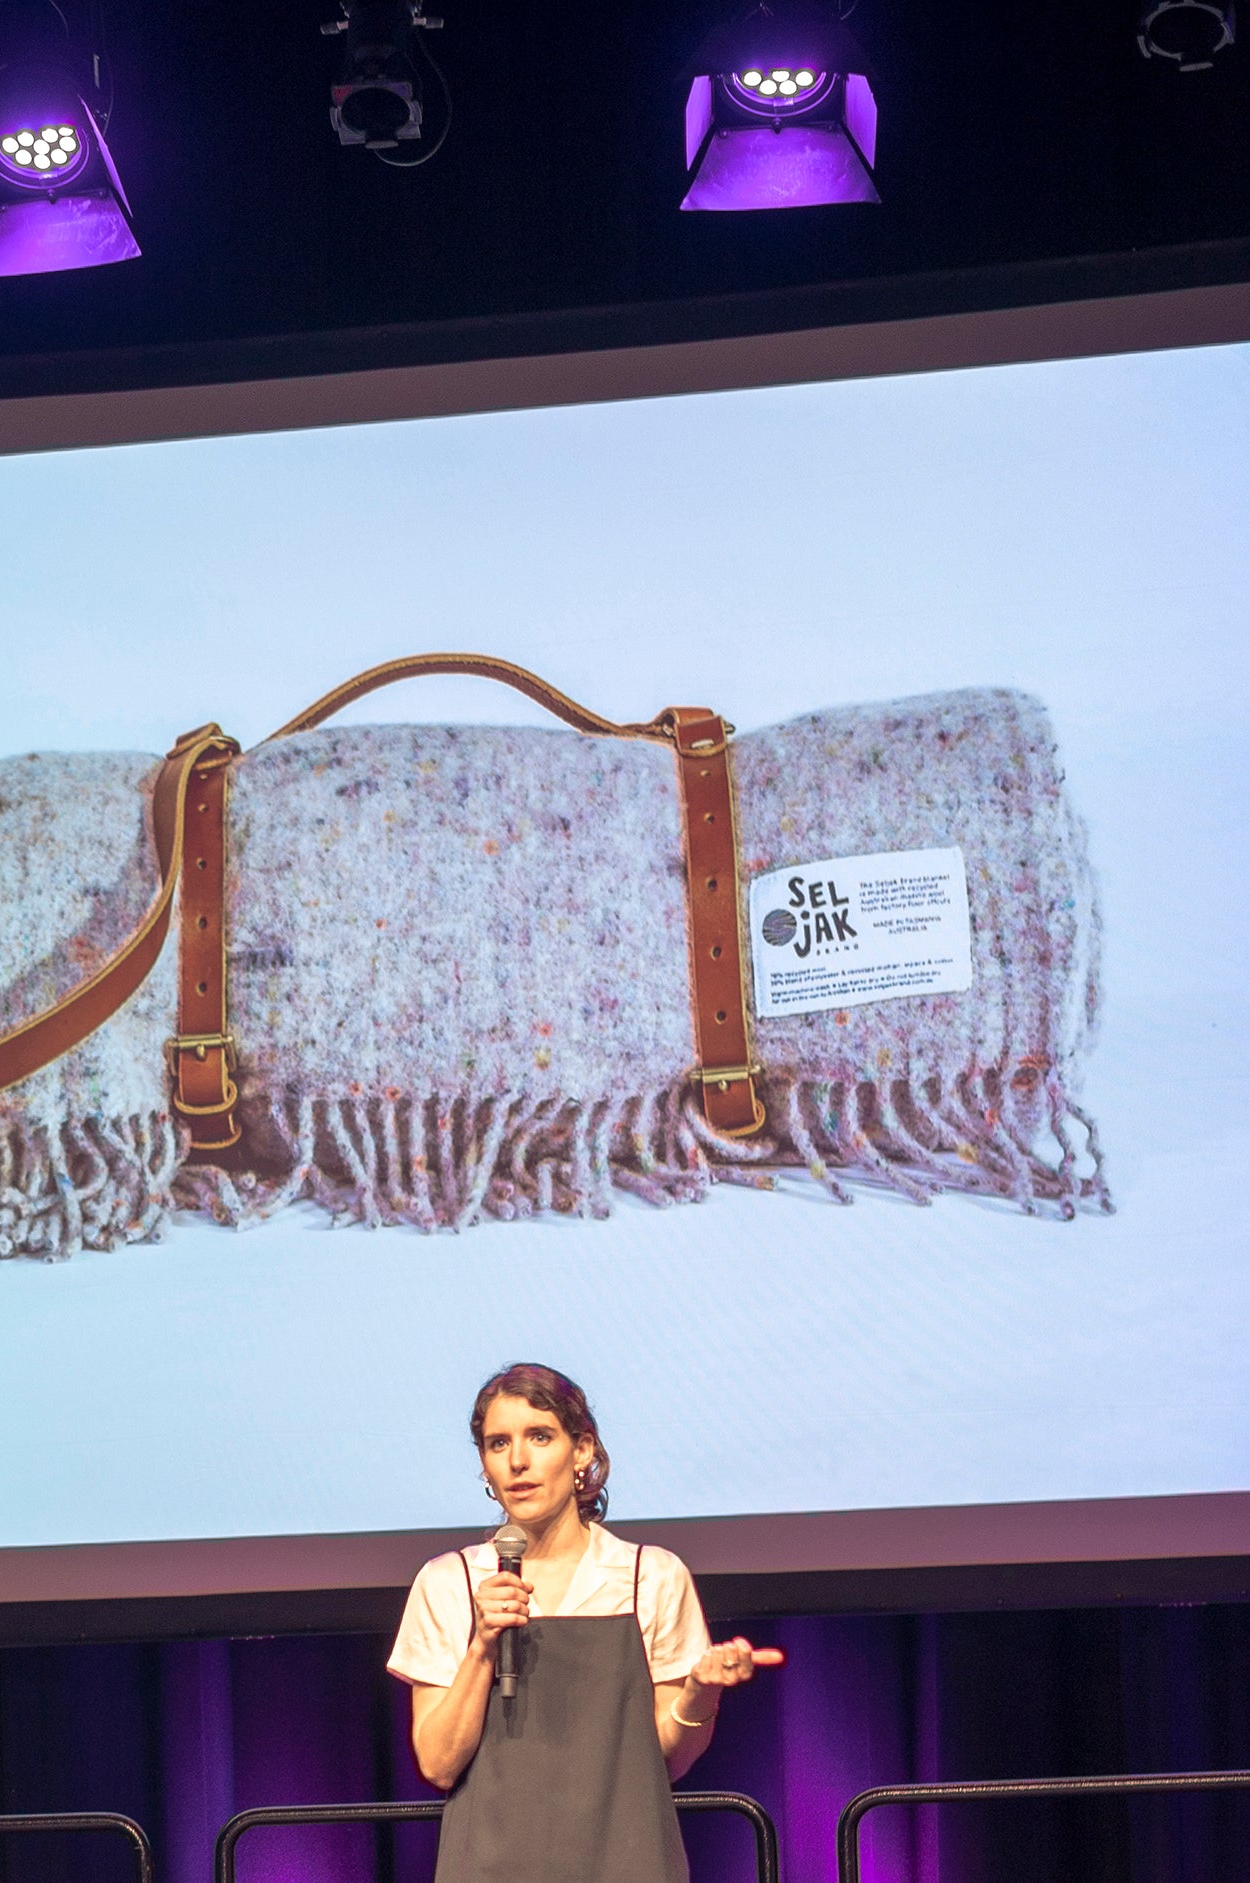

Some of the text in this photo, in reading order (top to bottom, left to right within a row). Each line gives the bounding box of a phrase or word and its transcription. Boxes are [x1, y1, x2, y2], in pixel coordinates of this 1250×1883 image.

[788, 876, 849, 909] SEL
[888, 925, 928, 934] AUSTRALIA
[816, 943, 859, 956] BRAND
